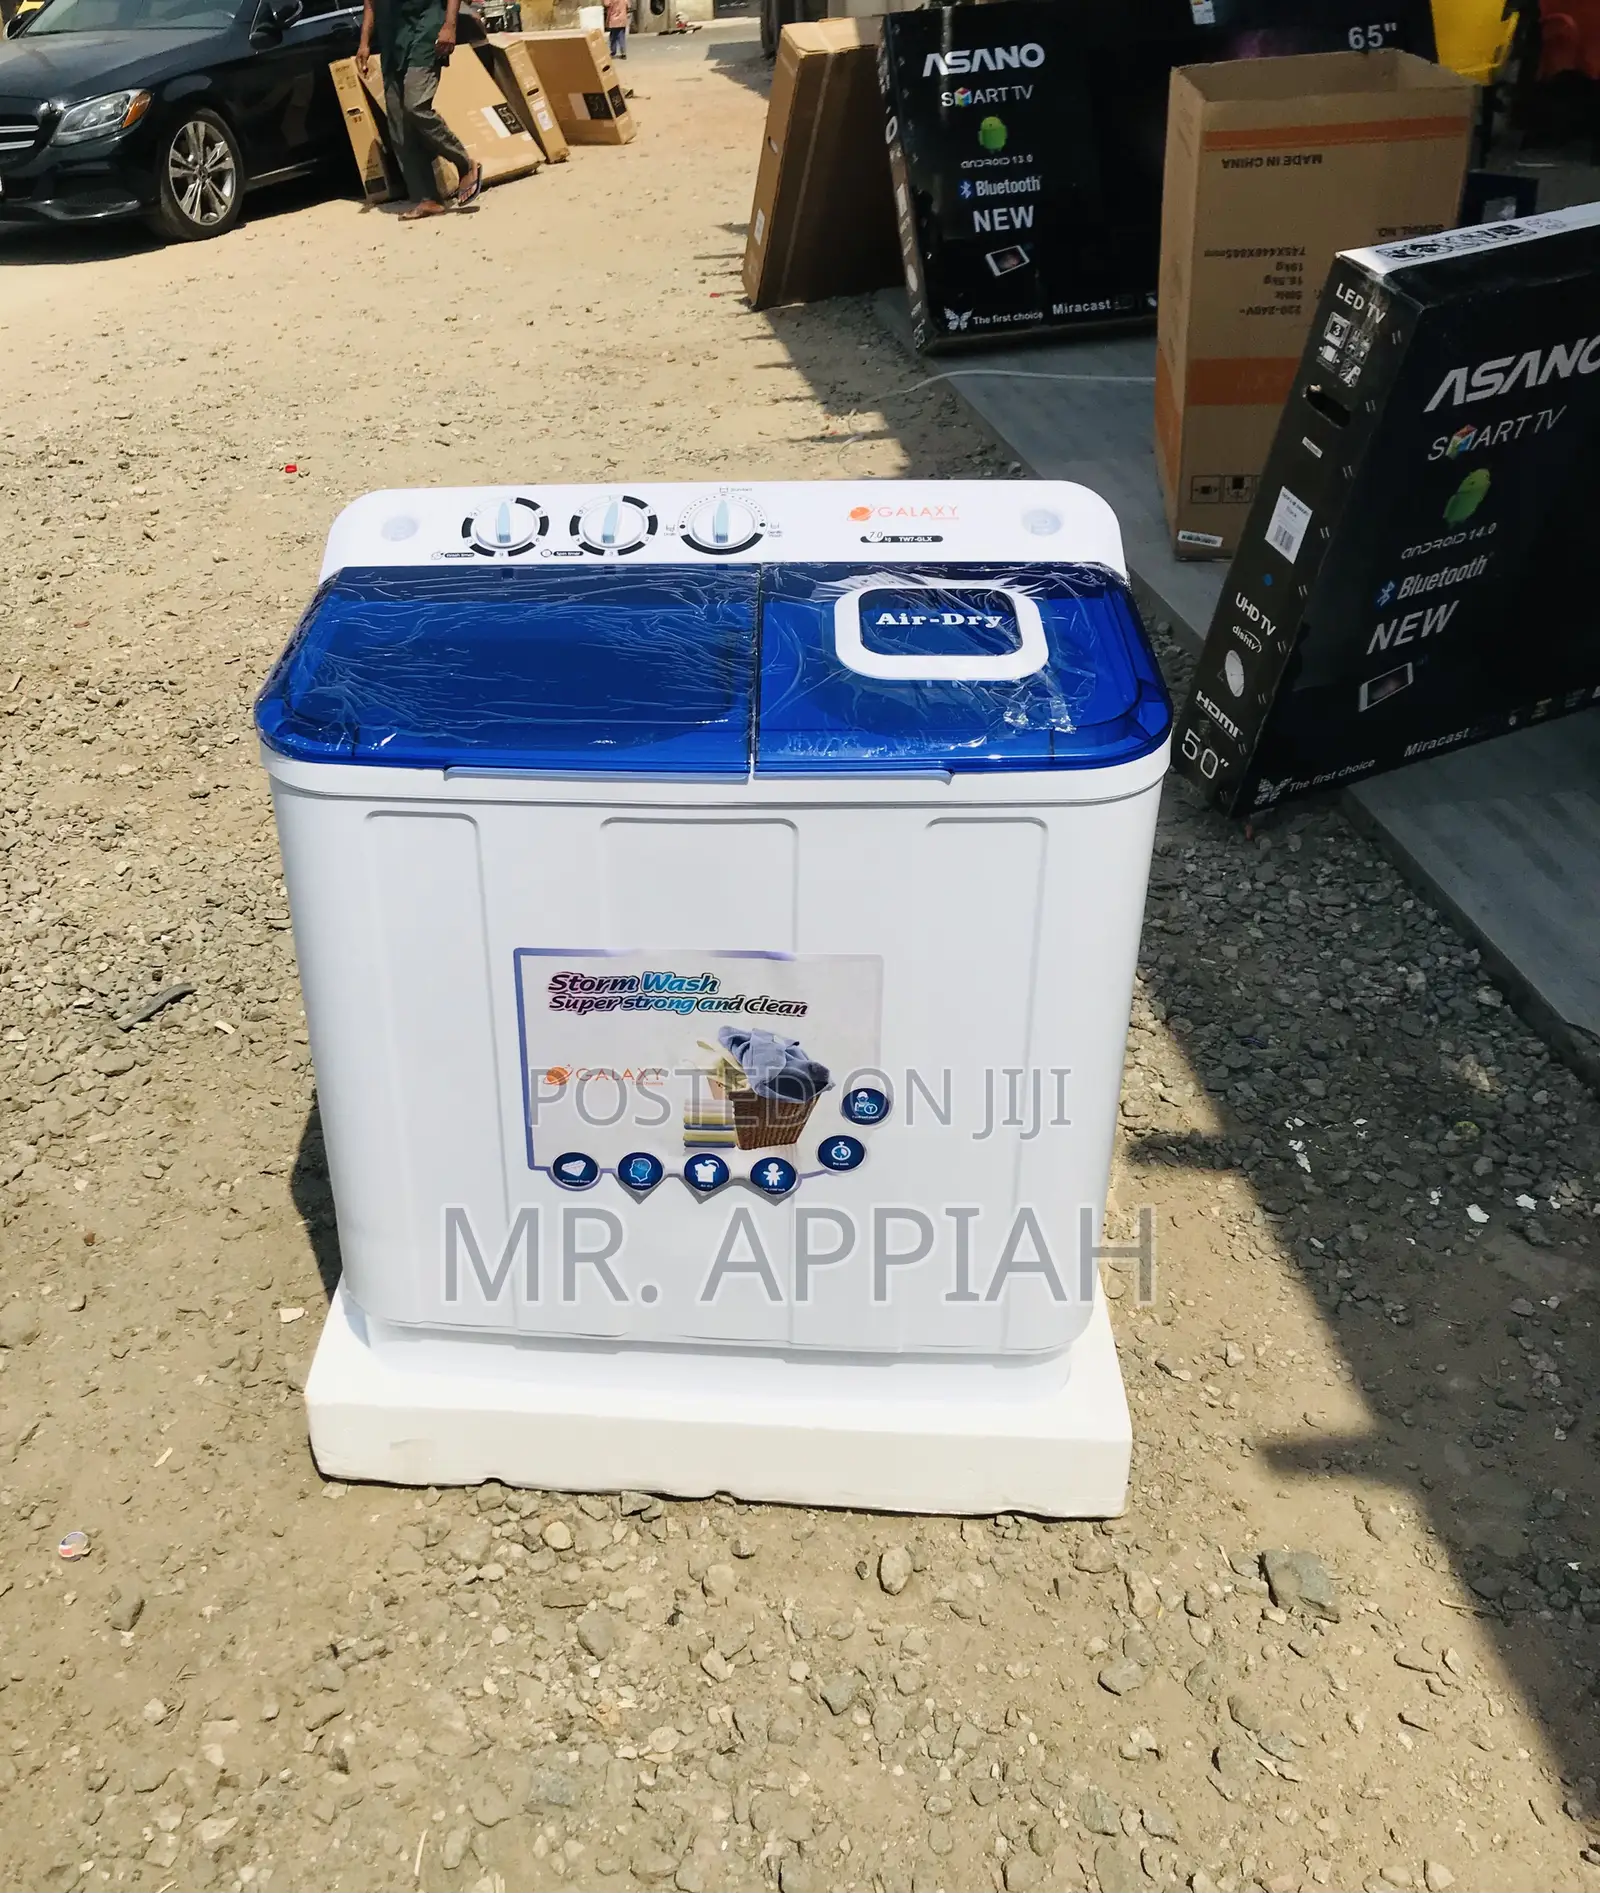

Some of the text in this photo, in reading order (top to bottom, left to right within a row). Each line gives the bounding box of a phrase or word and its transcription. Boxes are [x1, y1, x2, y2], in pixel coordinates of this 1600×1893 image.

[1349, 22, 1397, 49] 65"
[922, 43, 1045, 77] ASANO
[941, 85, 1034, 107] SMART TV
[1012, 154, 1033, 165] 13.0
[1221, 153, 1323, 169] MADE IN CHINA
[975, 176, 1041, 198] Bluetooth
[973, 205, 1034, 233] NEW
[1052, 299, 1111, 316] Miracast
[1335, 282, 1386, 324] LED TV
[973, 310, 1044, 325] The first choice
[1427, 404, 1567, 461] SMART TV
[877, 505, 958, 518] GALAXY
[1468, 522, 1498, 541] 14.0
[1397, 554, 1488, 600] Bluetooth
[875, 612, 1003, 629] Air-Dry
[1235, 592, 1277, 636] UHD TV
[1366, 600, 1460, 655] NEW
[1182, 728, 1229, 779] 50"
[1404, 727, 1470, 757] Miracast
[1289, 758, 1376, 793] The first choice
[548, 971, 720, 996] Storm Wash
[548, 993, 810, 1017] Super strong and clean
[576, 1067, 663, 1082] GALAXY
